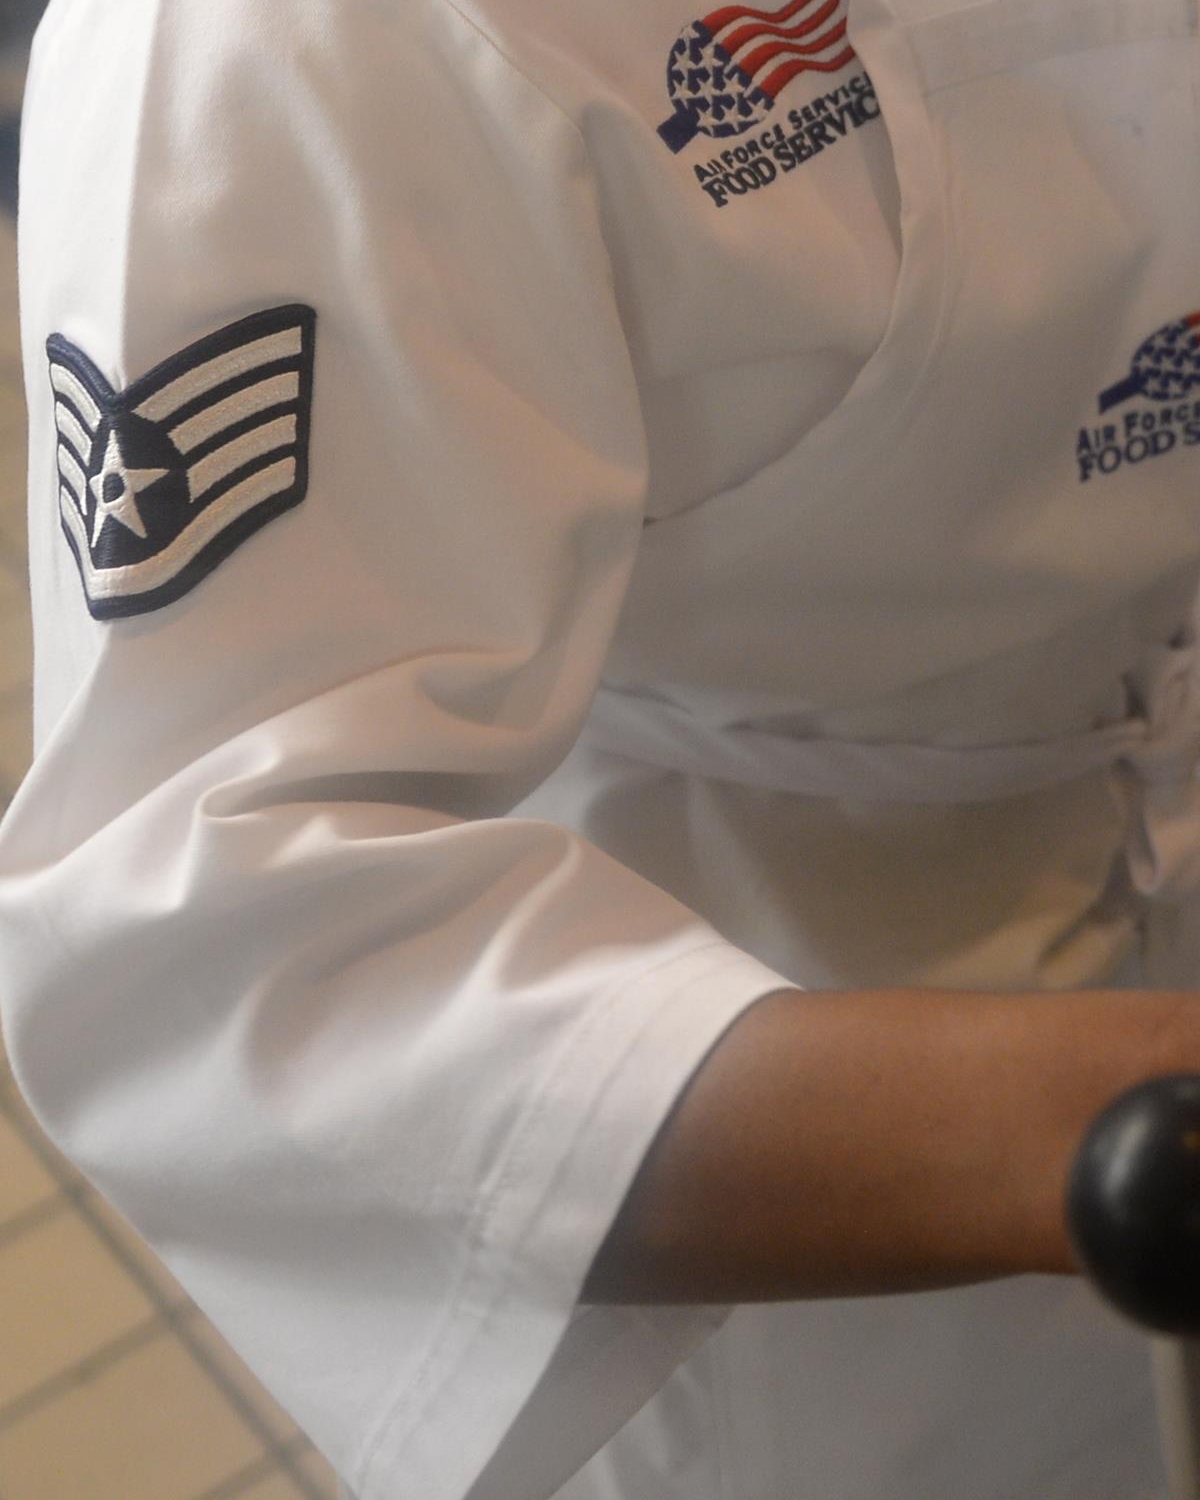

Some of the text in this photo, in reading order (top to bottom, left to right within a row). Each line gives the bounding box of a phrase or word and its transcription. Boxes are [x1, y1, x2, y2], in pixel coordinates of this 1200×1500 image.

[693, 159, 726, 182] AIR
[720, 123, 786, 169] FORCE
[702, 156, 777, 208] FOOD
[1077, 427, 1116, 451] AIR
